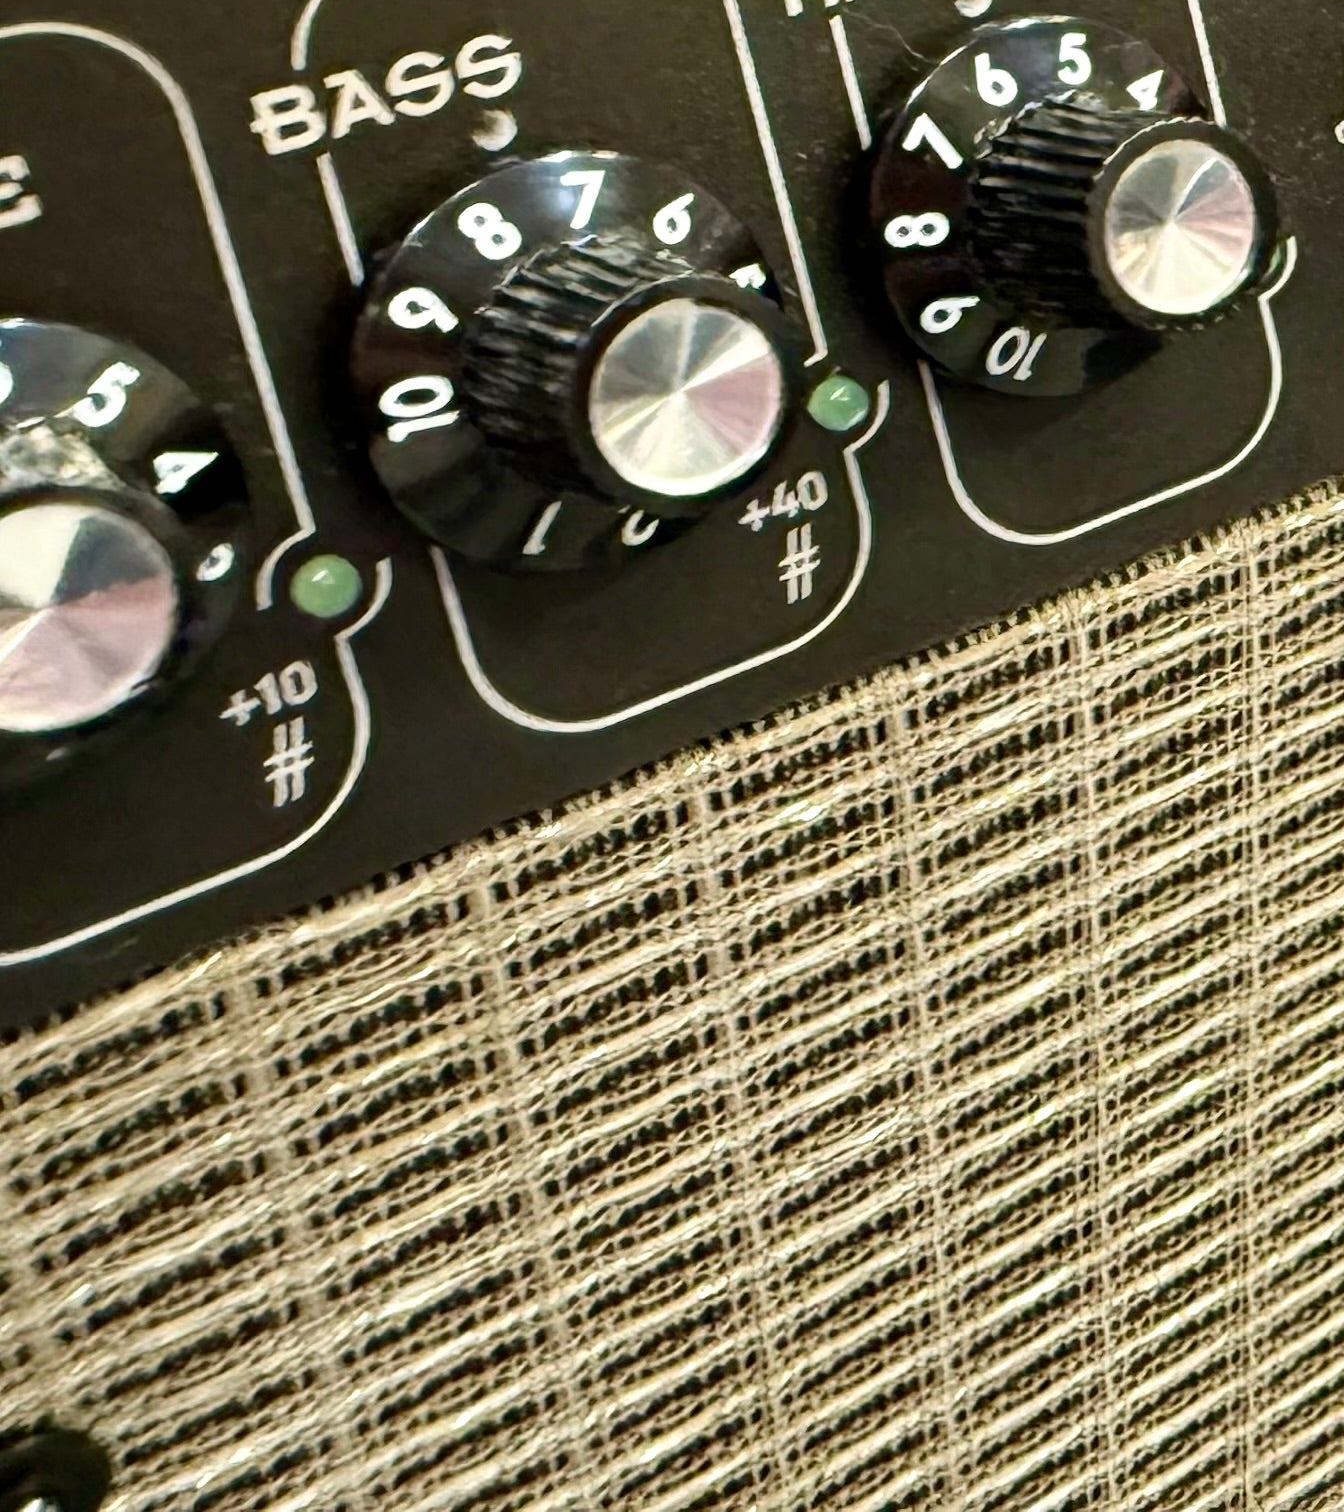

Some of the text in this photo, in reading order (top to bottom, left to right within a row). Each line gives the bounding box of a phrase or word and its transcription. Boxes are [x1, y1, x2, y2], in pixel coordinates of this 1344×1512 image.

[975, 53, 1018, 107] 6
[1058, 32, 1092, 85] 5
[250, 34, 522, 155] BASS
[903, 113, 965, 170] 7
[560, 170, 606, 229] 7
[653, 193, 695, 245] 6
[457, 202, 522, 260] 8
[884, 212, 950, 249] 8
[387, 287, 459, 333] 9
[986, 326, 1047, 381] 10
[72, 361, 141, 427] 5
[379, 375, 461, 443] 10
[738, 470, 828, 532] +40
[221, 659, 318, 726] +10
